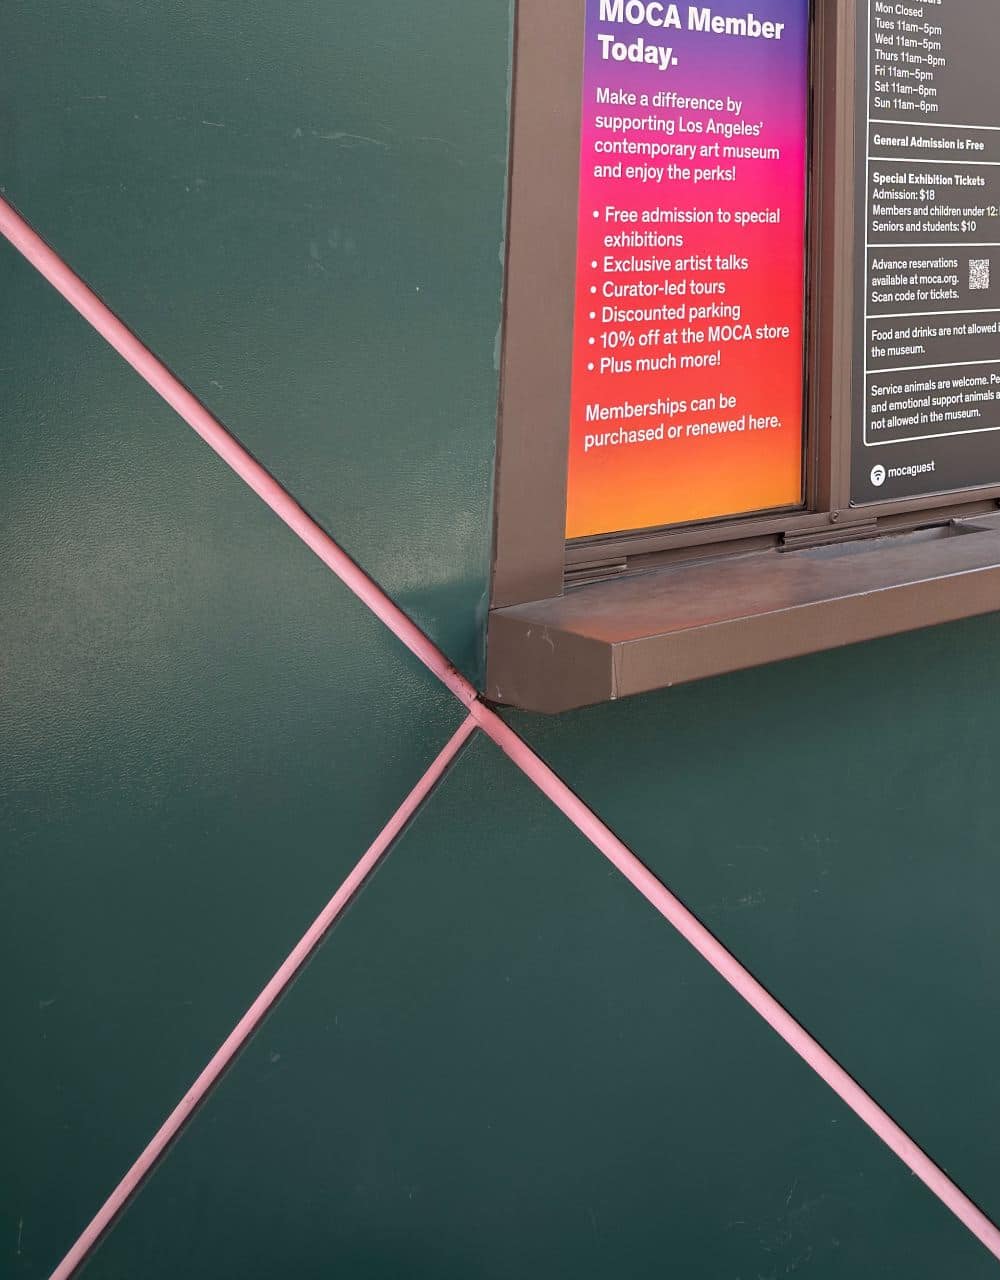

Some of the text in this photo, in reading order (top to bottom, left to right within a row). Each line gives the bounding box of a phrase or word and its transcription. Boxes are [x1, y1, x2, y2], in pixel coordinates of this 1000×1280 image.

[875, 2, 923, 17] Mon Closed
[688, 6, 784, 40] Member
[875, 18, 894, 29] Tues
[875, 33, 893, 45] Wed
[597, 34, 678, 70] Today.
[875, 49, 898, 61] Thurs
[875, 65, 885, 76] Fri
[875, 81, 889, 92] Sat
[596, 87, 742, 115] Make a difference by
[875, 97, 890, 108] Sun
[595, 116, 675, 135] supporting
[679, 117, 702, 133] Los
[595, 140, 780, 159] contemporary art museum
[874, 135, 908, 146] General
[910, 137, 955, 149] Admission
[966, 140, 984, 150] Free
[594, 164, 736, 183] and enjoy the perks!
[873, 172, 985, 186] Special Exhibition Tickets
[873, 189, 935, 201] Admission: $18
[605, 206, 780, 227] Free admission to special
[873, 205, 912, 216] Members
[914, 206, 928, 216] and
[930, 206, 961, 216] children
[963, 207, 984, 216] under
[987, 207, 998, 216] 12:
[873, 221, 976, 232] Seniors and students: $10
[604, 231, 683, 247] exhibitions
[603, 255, 748, 272] Exclusive artist talks
[872, 258, 958, 270] Advance reservations
[602, 280, 725, 297] Curator-led tours
[872, 274, 959, 286] available at moca.org.
[872, 289, 959, 302] Scan code for tickets.
[602, 303, 741, 323] Discounted parking
[600, 325, 789, 348] 10% off at the MOCA store
[872, 329, 892, 341] Food
[895, 328, 910, 339] and
[912, 326, 936, 338] drinks
[939, 327, 951, 336] are
[953, 325, 966, 335] not
[968, 323, 996, 334] allowed
[872, 345, 925, 357] the museum.
[600, 350, 720, 374] Plus much more!
[872, 385, 902, 396] Service
[904, 380, 936, 393] animals
[938, 380, 950, 389] are
[952, 377, 989, 387] welcome.
[586, 393, 736, 421] Memberships can be
[872, 400, 887, 412] and
[889, 396, 930, 411] emotional
[932, 393, 963, 407] support
[965, 391, 994, 401] animals
[872, 409, 981, 430] not allowed in the museum.
[584, 413, 781, 452] purchased or renewed here.
[888, 460, 935, 478] mocaguest
